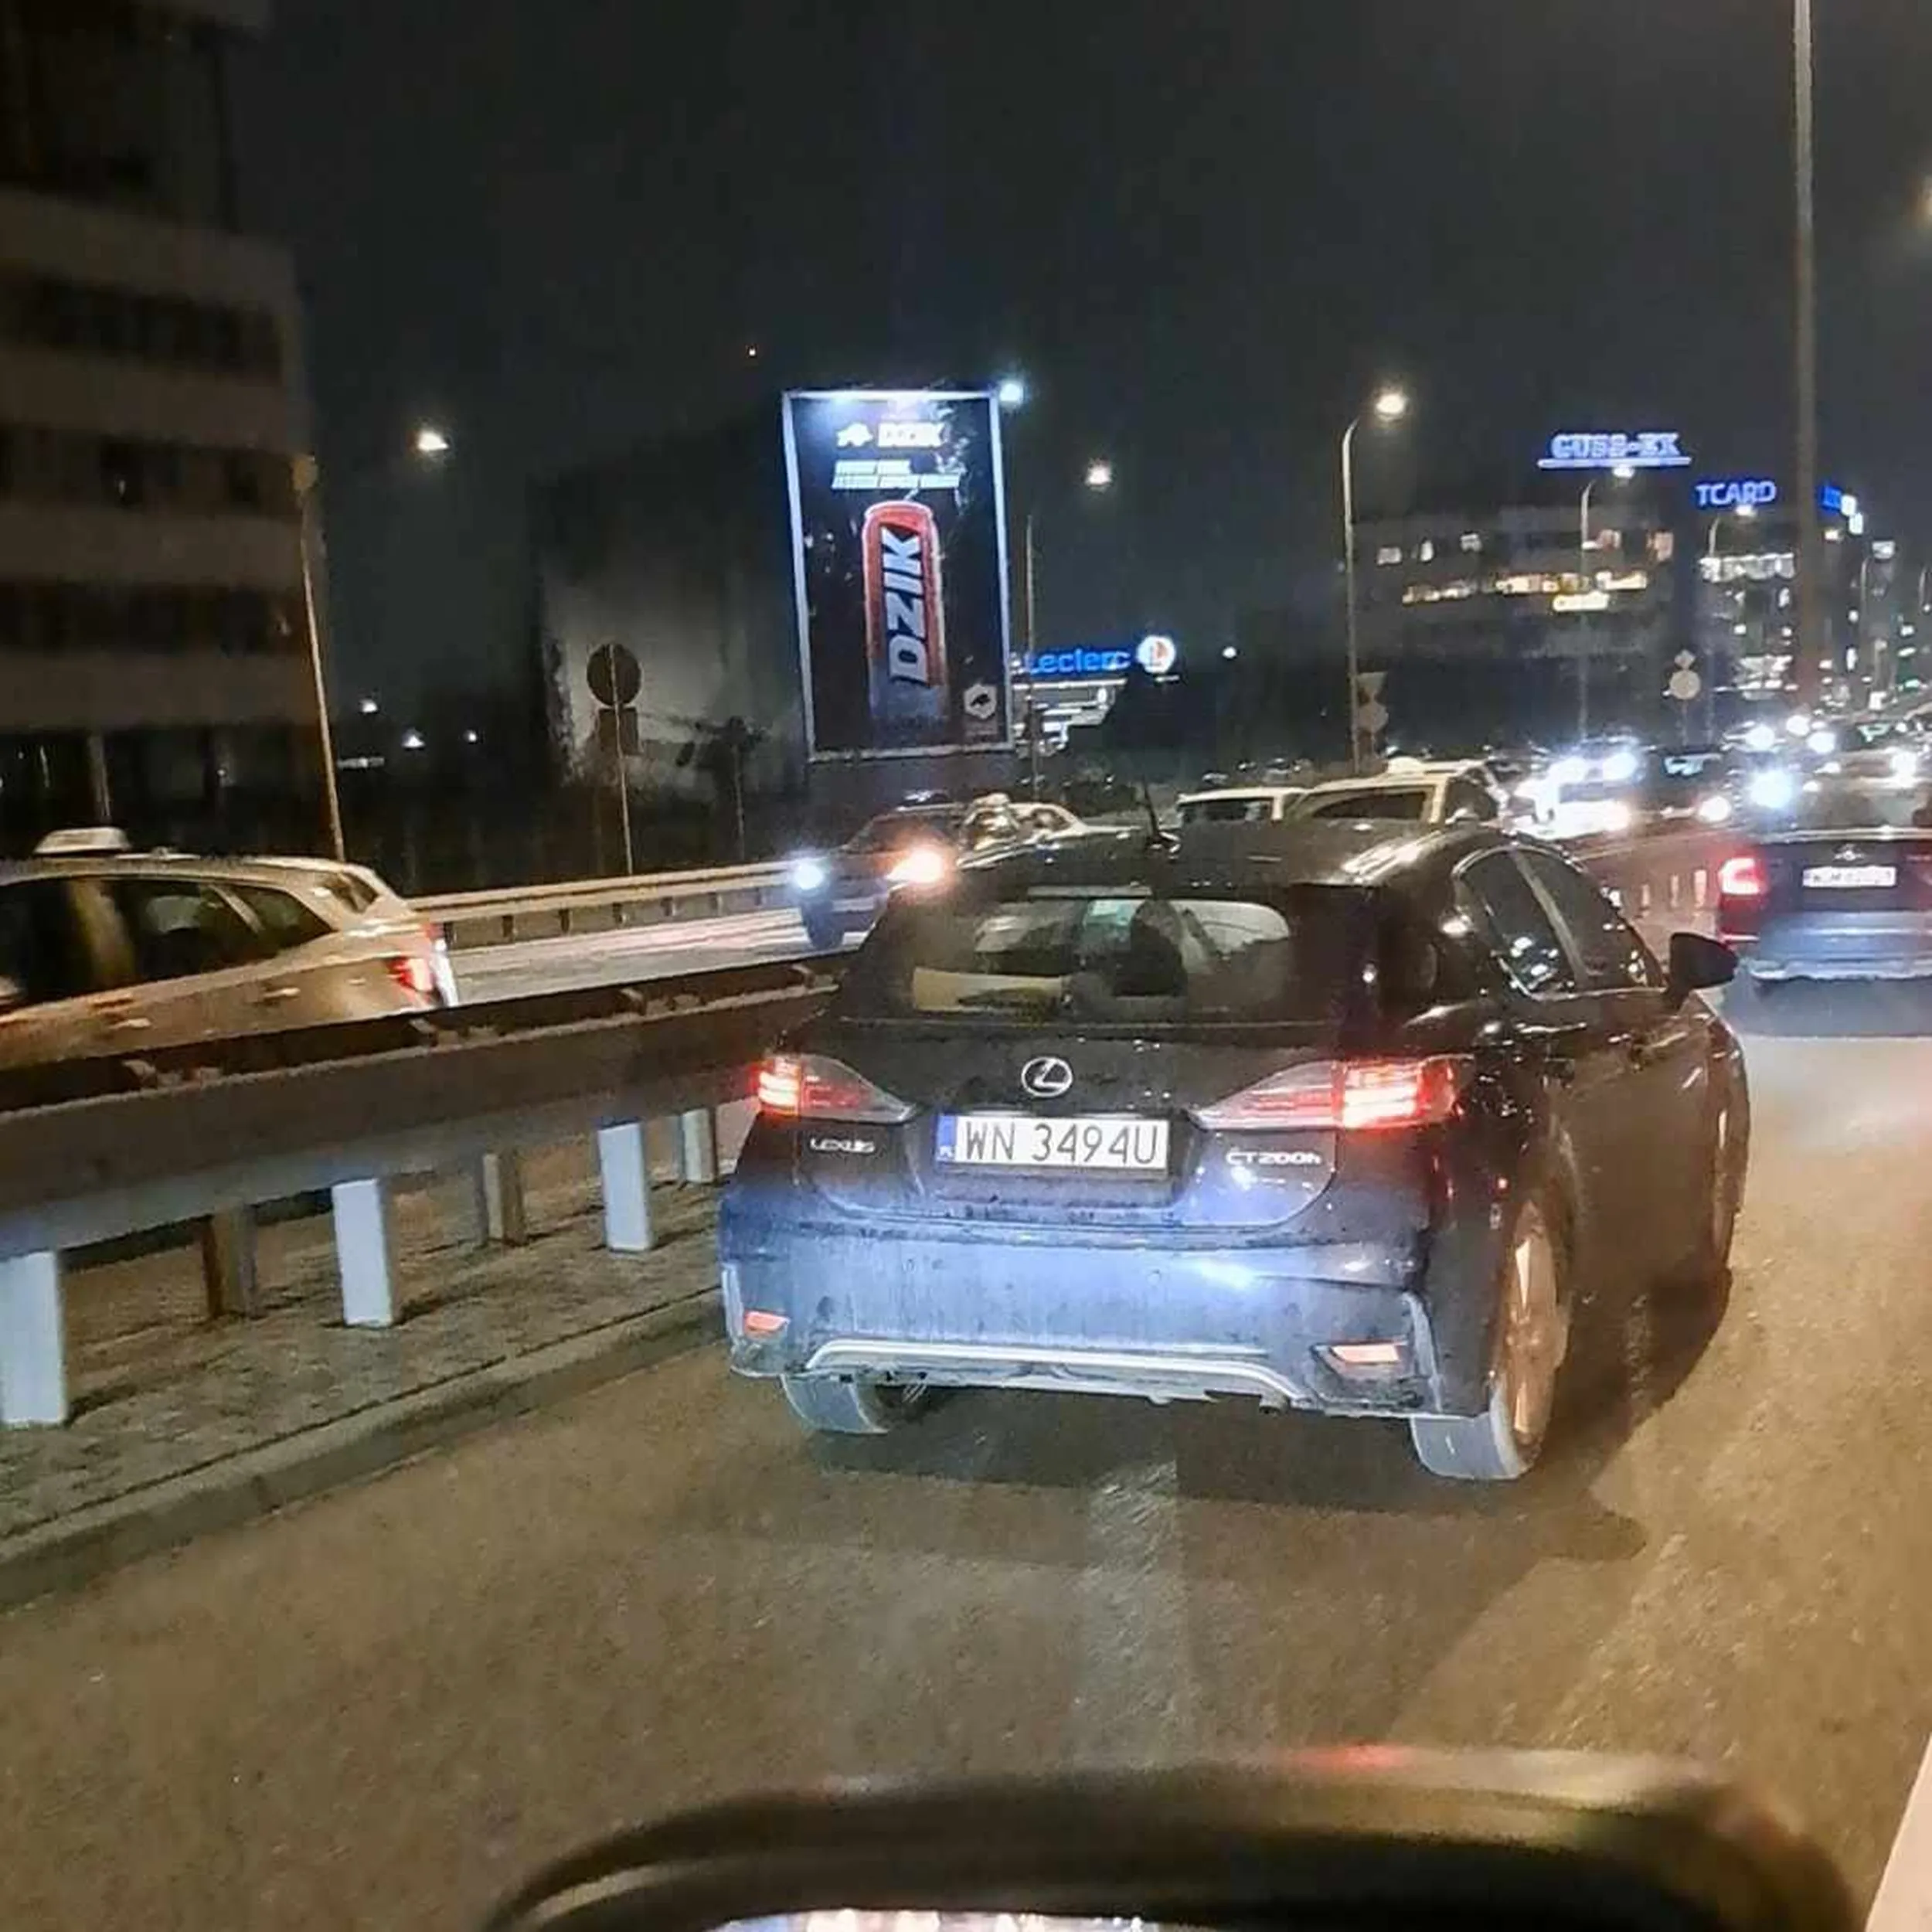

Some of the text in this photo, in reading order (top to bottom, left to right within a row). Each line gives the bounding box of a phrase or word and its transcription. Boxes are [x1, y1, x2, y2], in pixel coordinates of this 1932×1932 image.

[880, 526, 928, 683] DZIK
[966, 1121, 1158, 1165] WN 3494U
